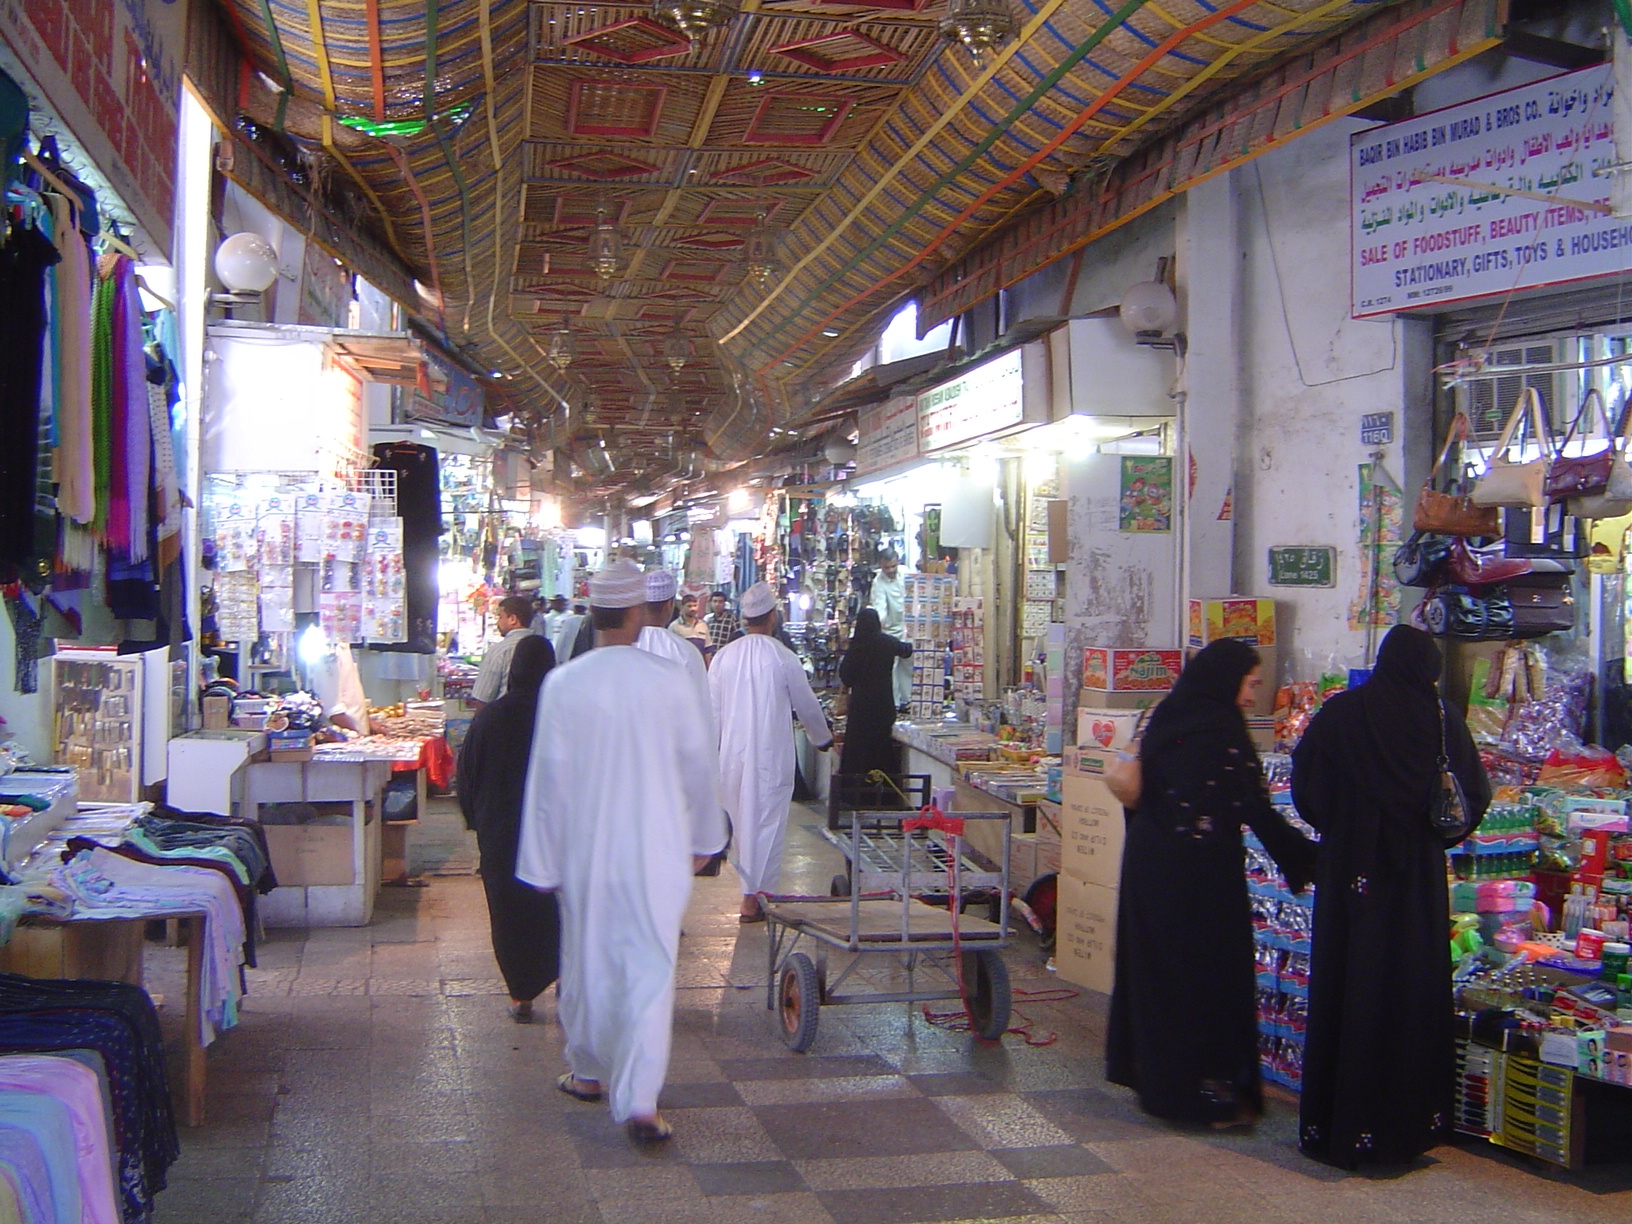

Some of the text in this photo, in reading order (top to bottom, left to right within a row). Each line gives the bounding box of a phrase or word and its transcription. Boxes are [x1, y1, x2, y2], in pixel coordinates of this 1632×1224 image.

[1360, 99, 1542, 167] BAQIR BIN HABIB BIN MURAD & BROS CO.
[1361, 244, 1388, 267] SALE
[1394, 240, 1408, 260] OF
[1490, 211, 1541, 240] BEAUTY
[1395, 257, 1471, 288] STATIONARY,
[1473, 249, 1513, 272] GIFTS,
[1515, 242, 1547, 266] TOYS
[1556, 238, 1565, 258] &
[1362, 429, 1388, 443] 1160
[1300, 570, 1319, 580] 1425
